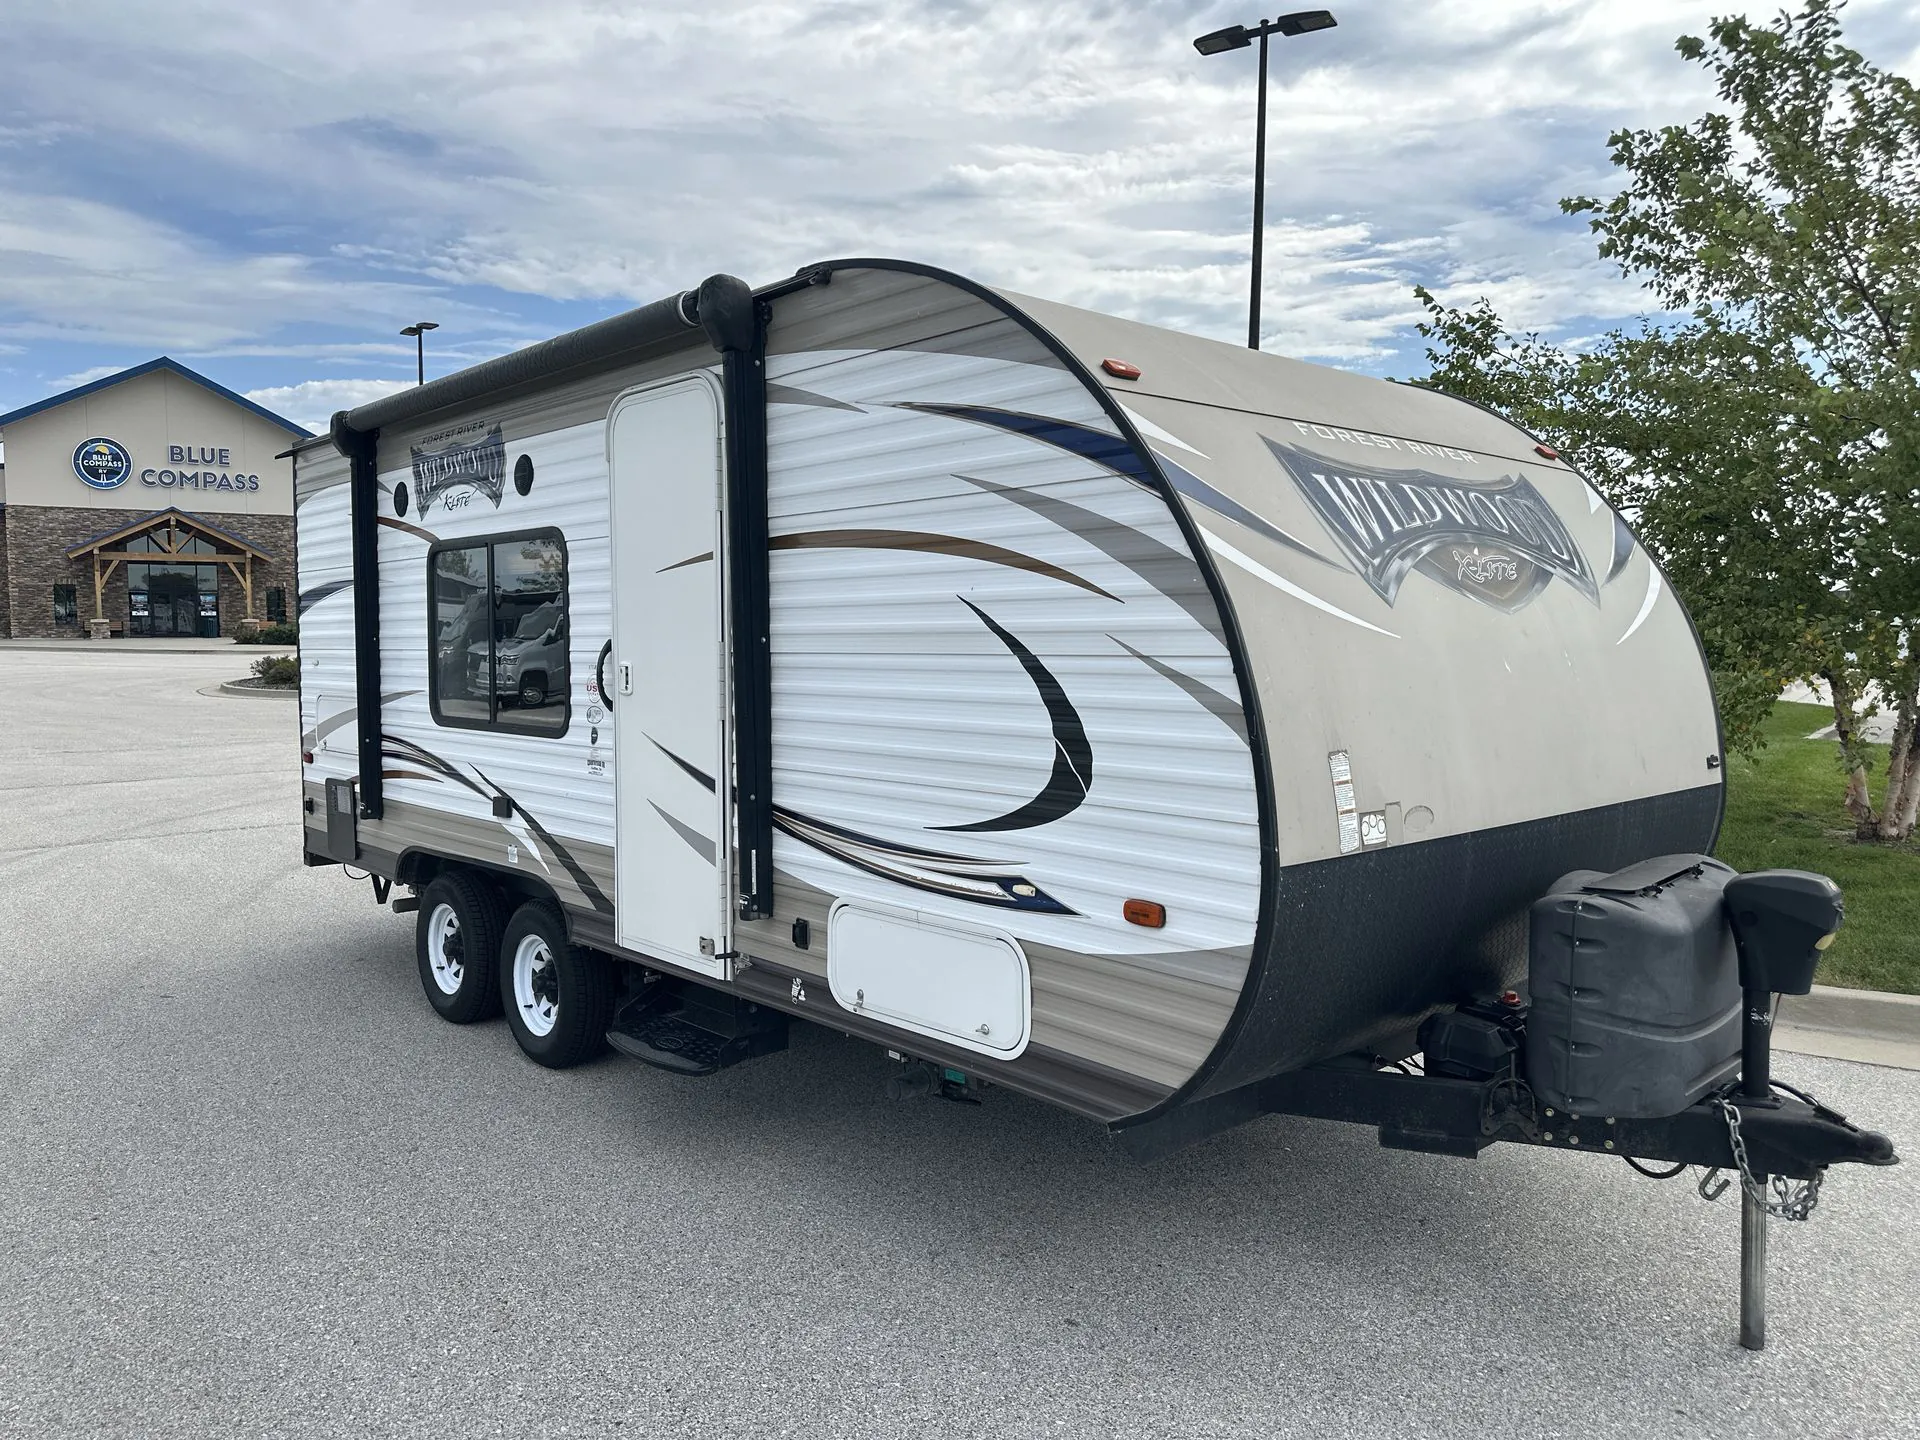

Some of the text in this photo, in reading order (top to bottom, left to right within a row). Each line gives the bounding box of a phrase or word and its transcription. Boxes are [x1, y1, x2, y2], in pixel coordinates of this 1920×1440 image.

[422, 420, 485, 445] FOREST RIVER
[1292, 421, 1479, 464] FOREST RIVER
[83, 459, 122, 468] COMPASS
[169, 445, 231, 467] BLUE
[140, 468, 260, 492] COMPASS
[1310, 471, 1572, 561] WILDWOOD
[1452, 550, 1518, 583] X-LITE
